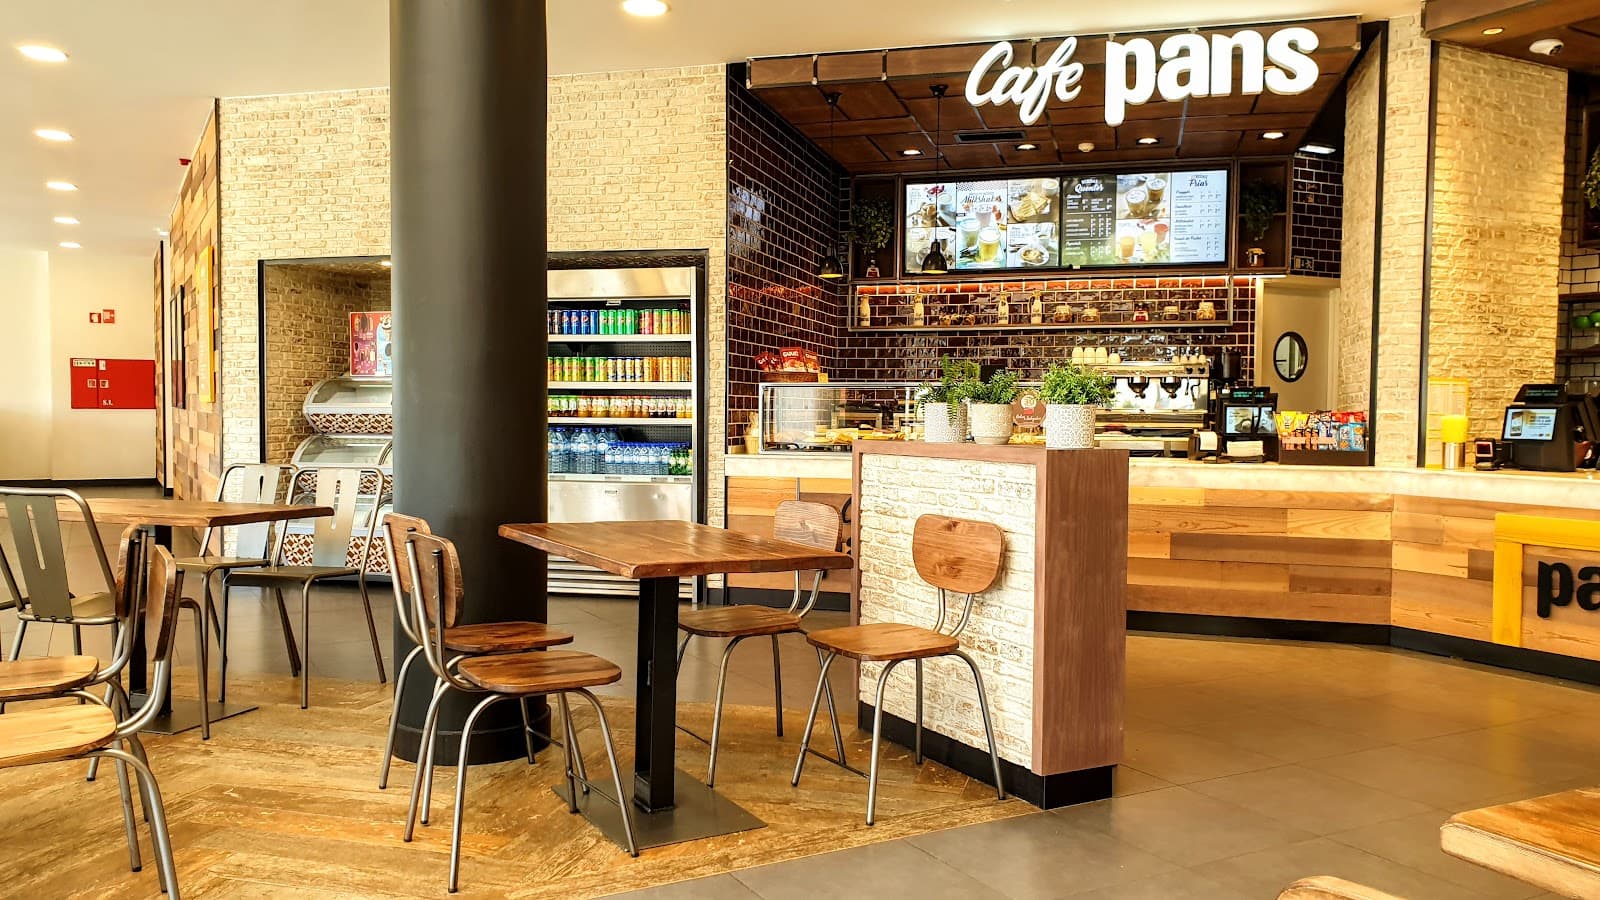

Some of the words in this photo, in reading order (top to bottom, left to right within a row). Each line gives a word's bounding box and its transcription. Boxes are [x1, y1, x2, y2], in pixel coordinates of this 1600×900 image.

[965, 36, 1085, 126] Cafe
[1104, 26, 1320, 127] pans
[1537, 560, 1600, 619] pa
